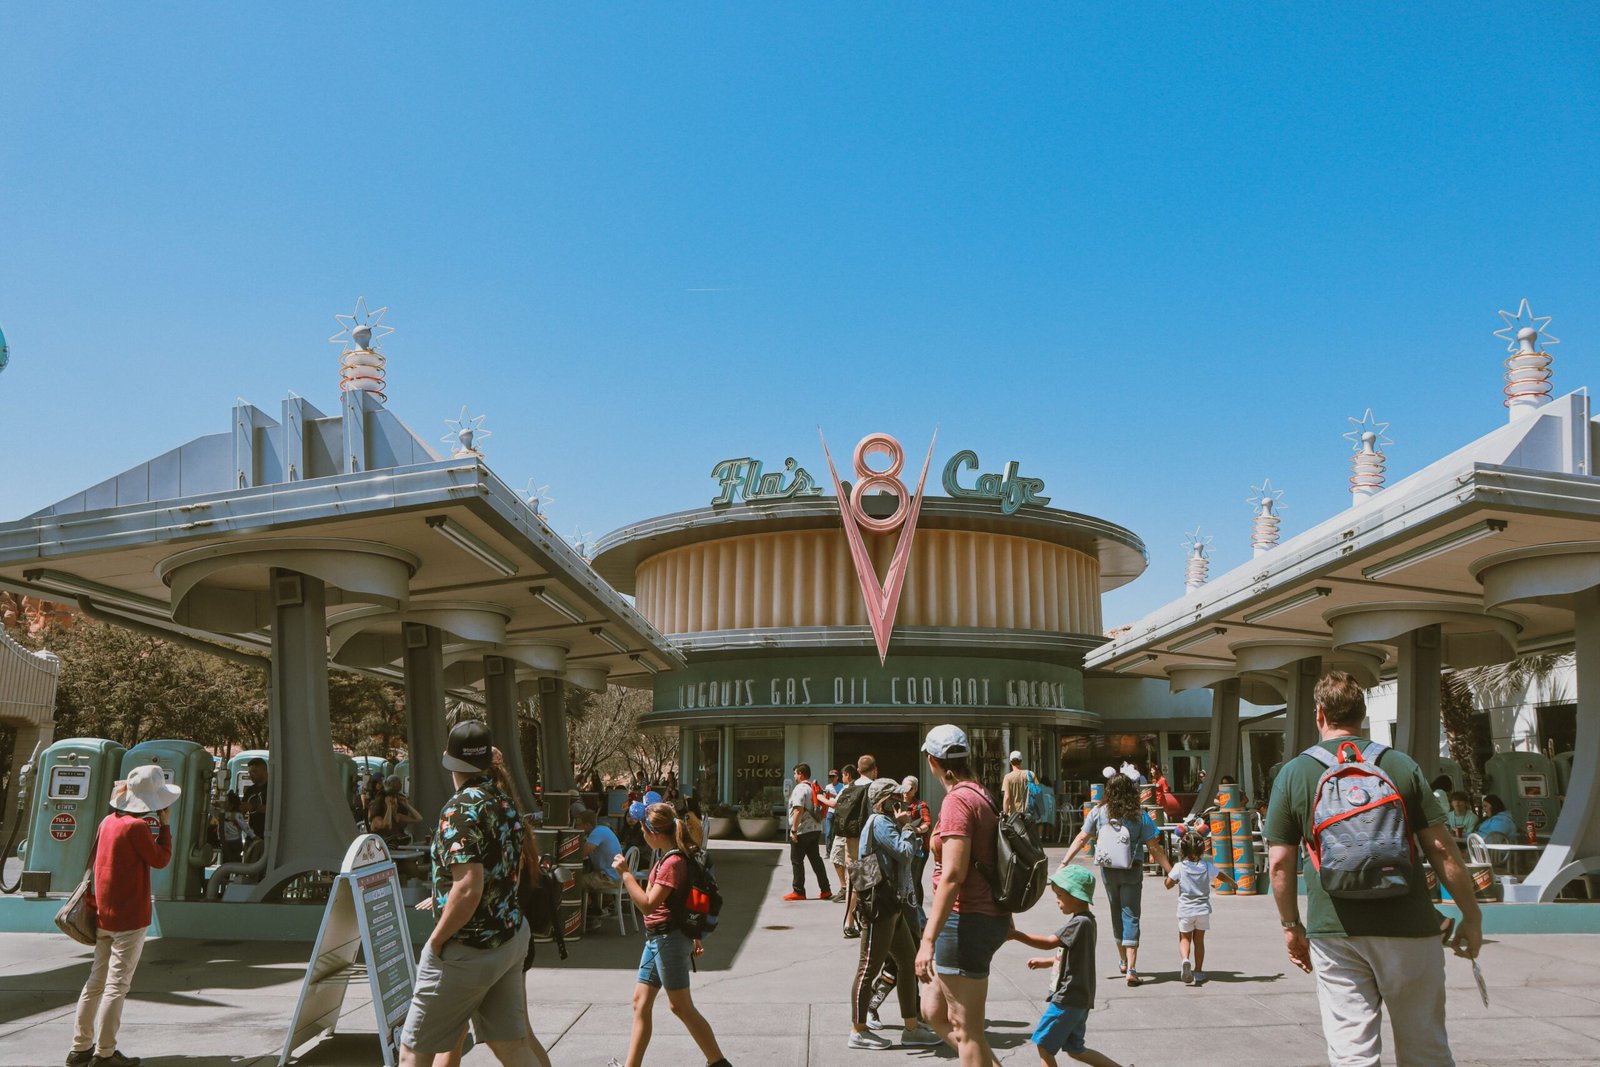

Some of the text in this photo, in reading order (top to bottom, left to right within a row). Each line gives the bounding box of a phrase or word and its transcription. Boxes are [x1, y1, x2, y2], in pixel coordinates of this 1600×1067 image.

[711, 457, 824, 505] Flo's
[942, 450, 1051, 515] Cafe
[770, 677, 811, 705] GAS
[834, 677, 870, 705] OIL
[891, 677, 990, 706] COOLANT
[747, 754, 769, 764] DIP
[736, 768, 782, 779] STICKS
